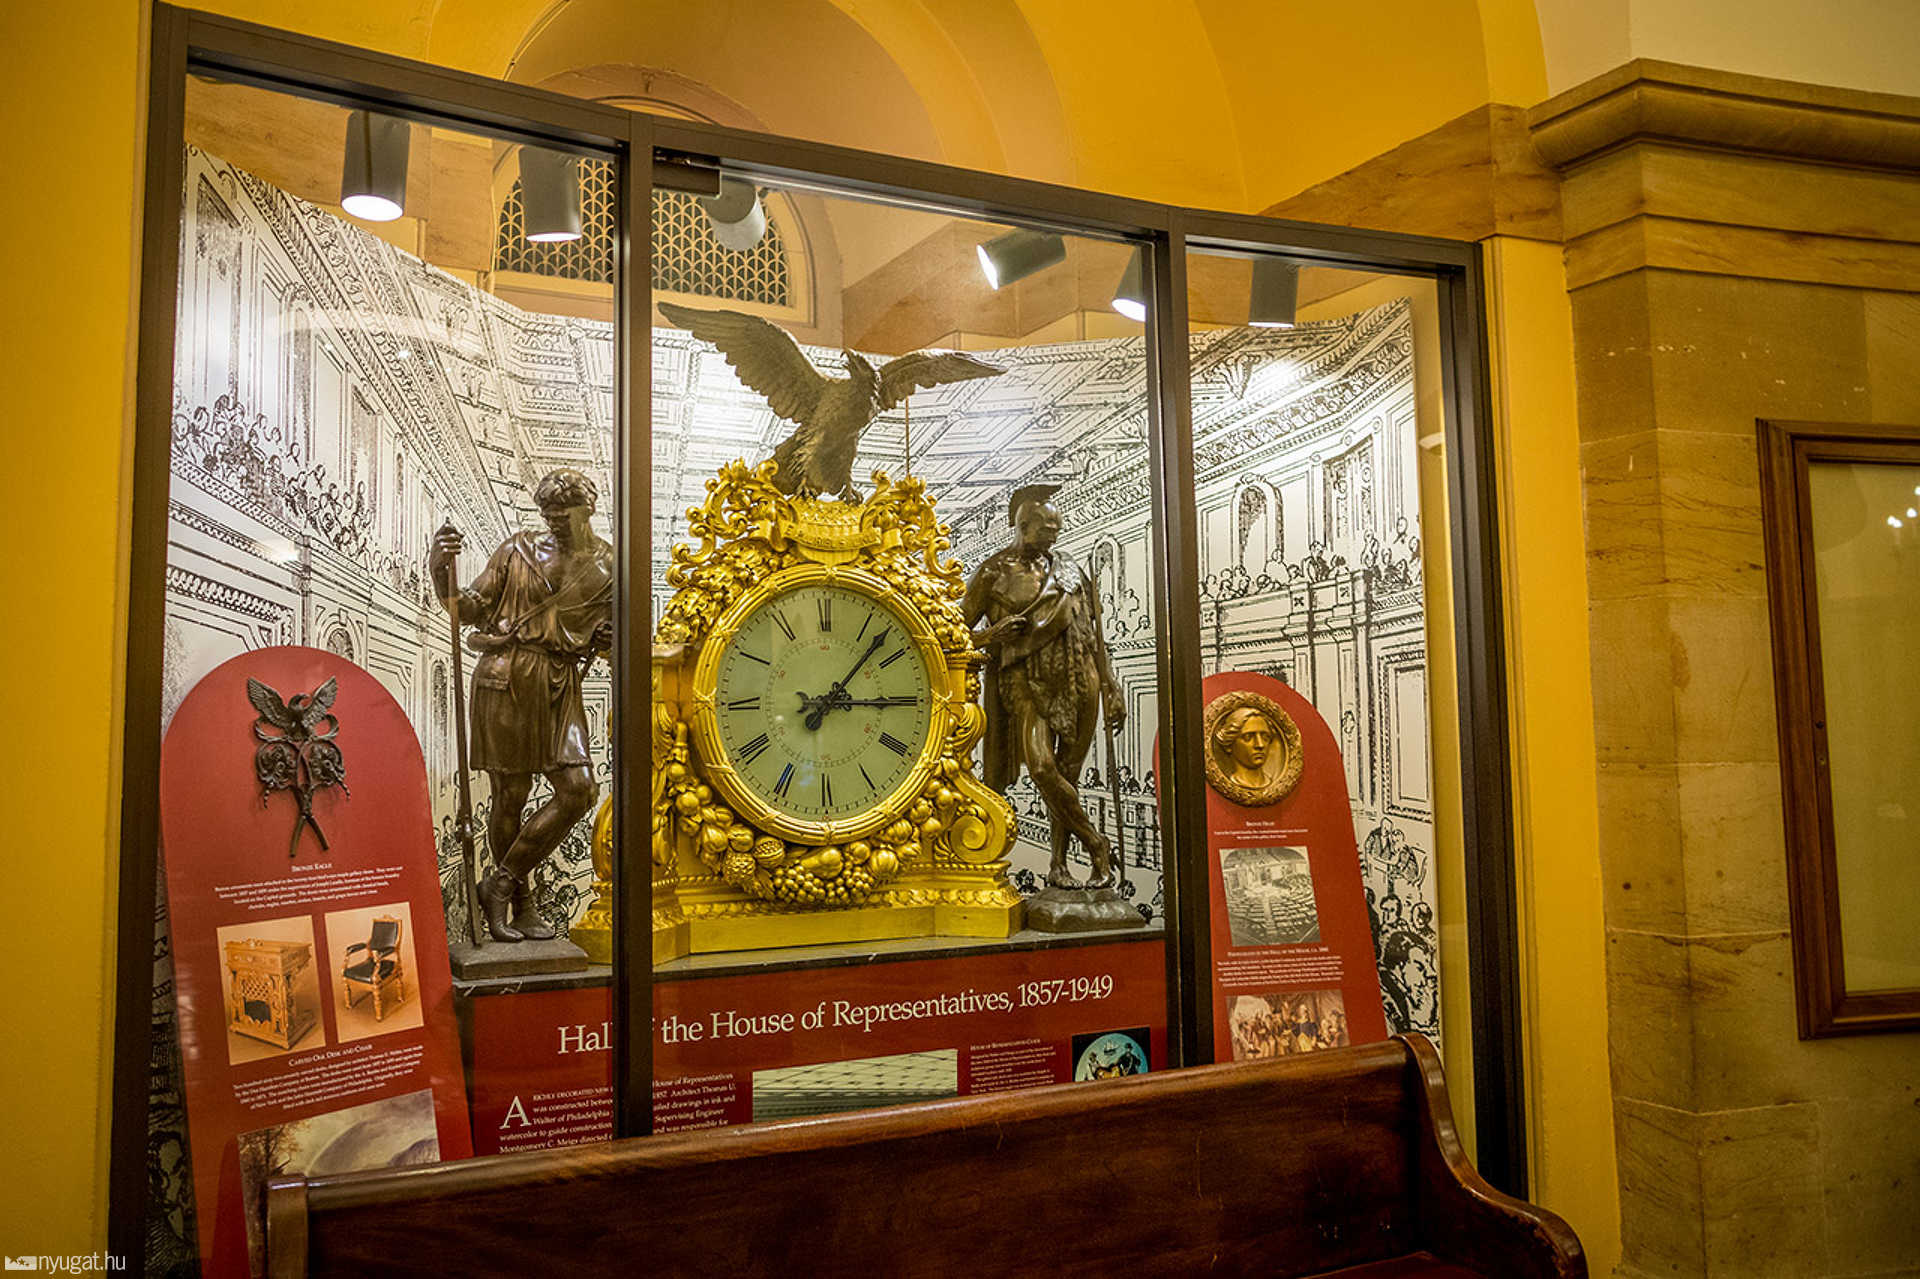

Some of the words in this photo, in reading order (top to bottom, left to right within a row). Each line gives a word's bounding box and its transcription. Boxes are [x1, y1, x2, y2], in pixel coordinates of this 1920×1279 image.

[557, 1021, 613, 1055] Hal
[661, 1016, 703, 1044] the
[710, 1010, 794, 1039] House
[801, 1002, 827, 1029] of
[832, 988, 1014, 1032] Representatives,
[1018, 974, 1113, 1008] 1857-1949
[723, 1094, 736, 1103] and
[499, 1095, 532, 1130] A
[533, 1104, 547, 1113] was
[548, 1099, 589, 1111] constructed
[566, 1110, 610, 1122] Philadelphia
[695, 1108, 724, 1118] Engineer
